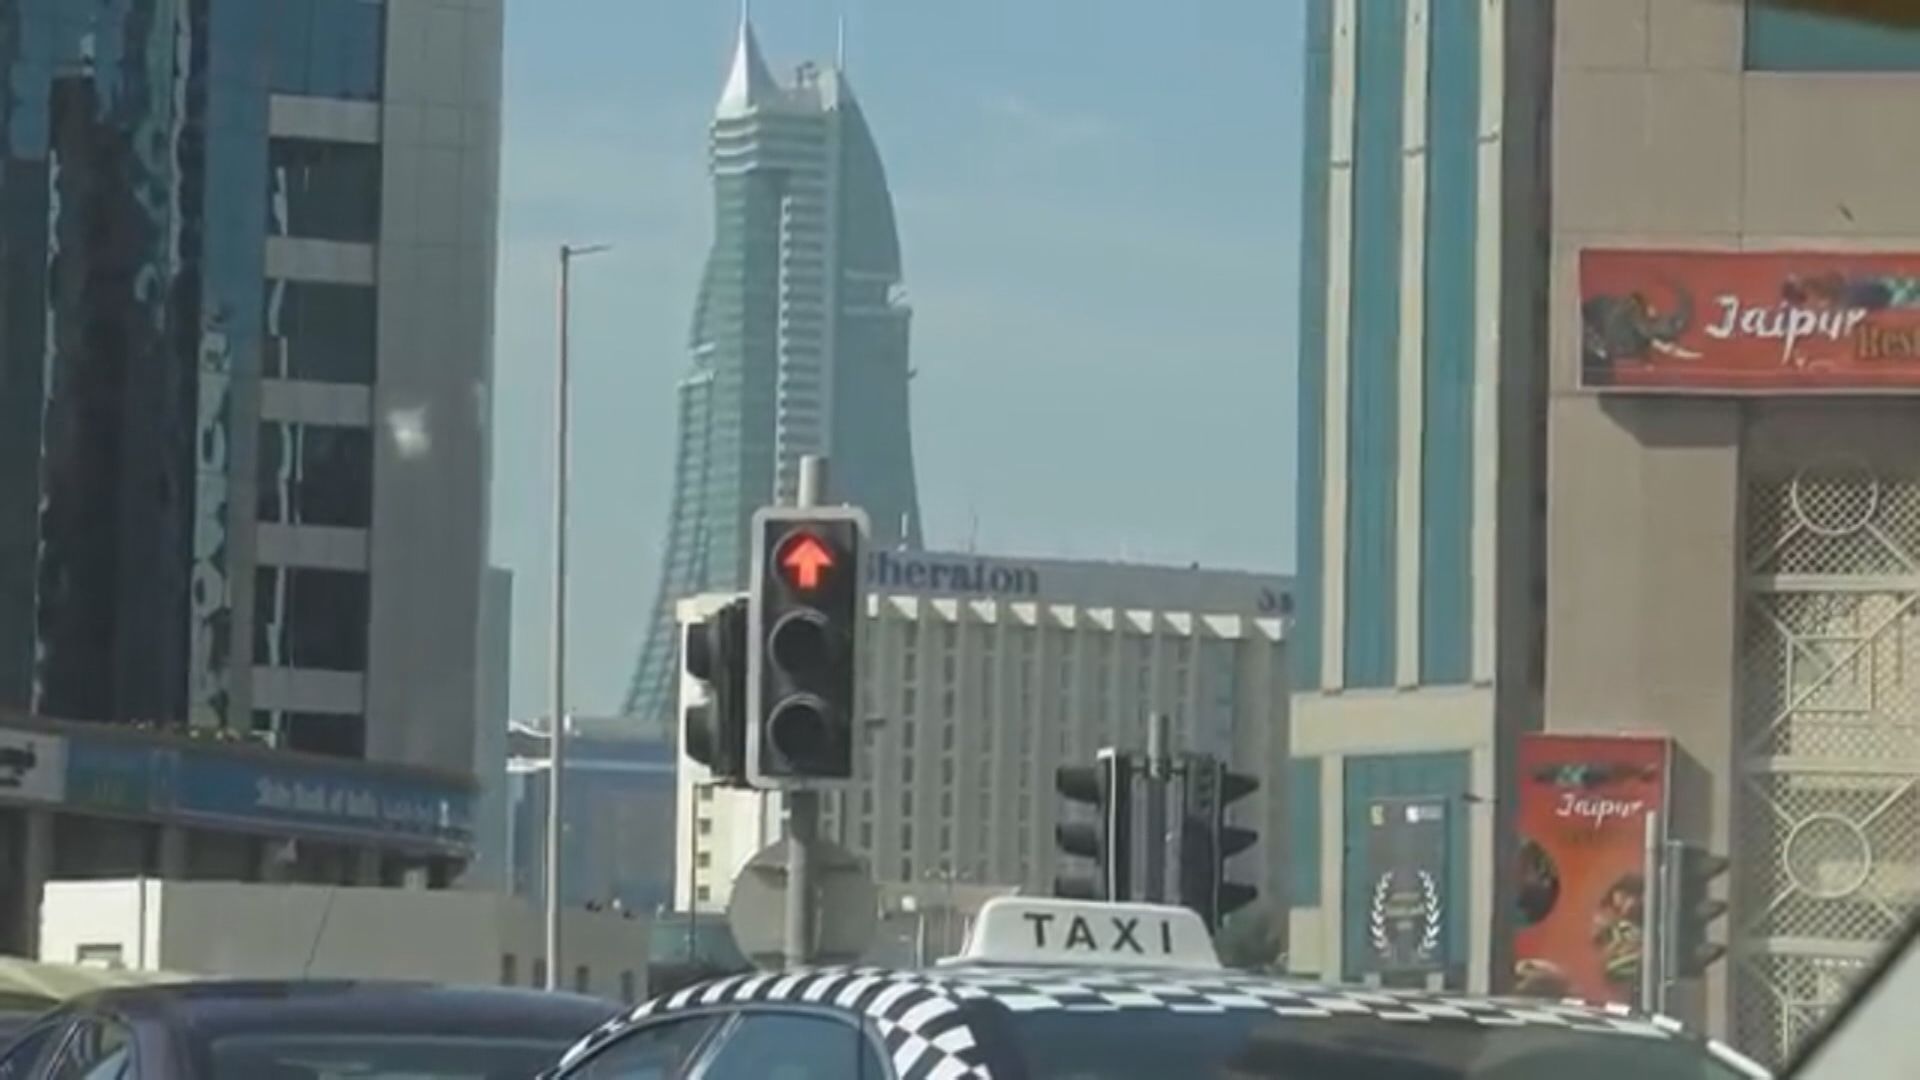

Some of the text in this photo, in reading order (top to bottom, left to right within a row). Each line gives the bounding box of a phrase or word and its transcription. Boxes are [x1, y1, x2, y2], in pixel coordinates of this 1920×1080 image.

[1705, 296, 1867, 364] Jaipur
[1555, 793, 1644, 829] Jaipur
[1024, 912, 1172, 954] TAXI
